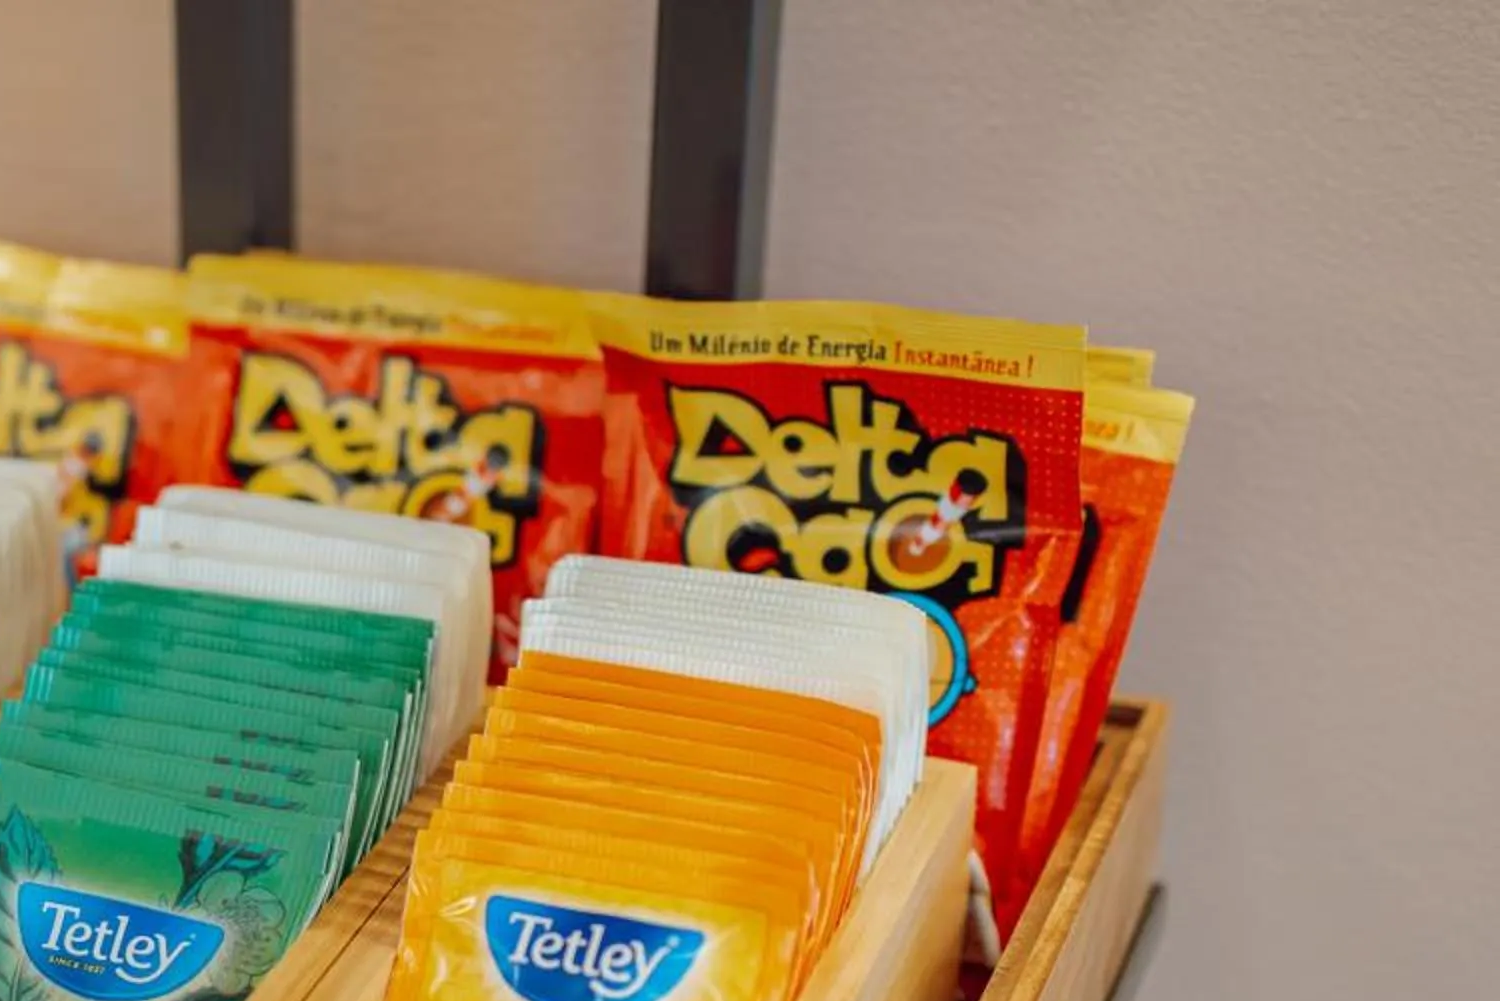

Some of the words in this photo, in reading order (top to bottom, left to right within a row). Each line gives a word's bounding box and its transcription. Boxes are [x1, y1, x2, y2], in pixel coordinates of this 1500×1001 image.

[649, 331, 683, 354] Um
[689, 332, 771, 356] Milénio
[777, 335, 800, 356] de
[806, 335, 887, 364] Energia
[894, 339, 1021, 377] Instantânea
[229, 352, 535, 498] Delta
[667, 383, 1009, 522] Delta
[41, 900, 193, 985] Tetley
[507, 910, 673, 1000] Tetley
